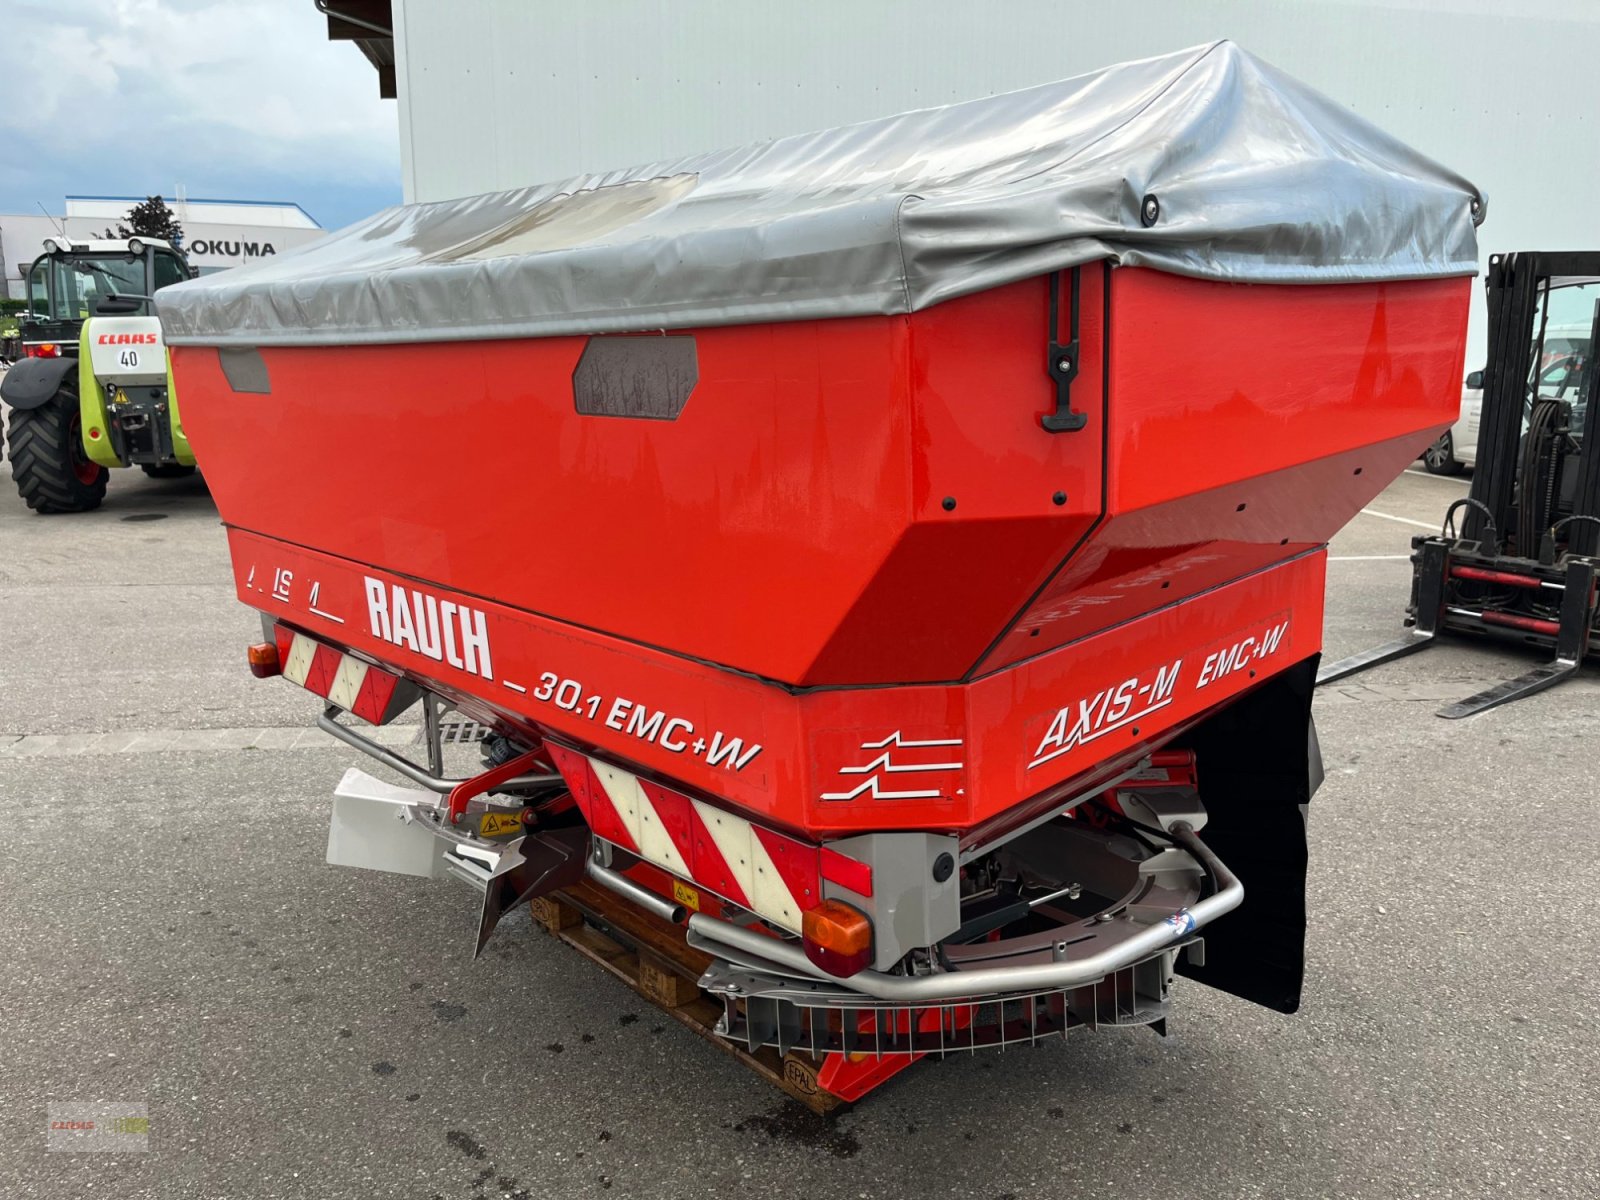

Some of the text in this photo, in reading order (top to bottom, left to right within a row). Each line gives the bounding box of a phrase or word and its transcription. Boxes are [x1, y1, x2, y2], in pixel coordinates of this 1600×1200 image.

[191, 240, 276, 256] OKUMA
[98, 333, 157, 345] CLAAS
[120, 351, 138, 367] 40
[364, 576, 493, 680] RAUCH
[1034, 621, 1288, 757] AXIS-M EMC+W
[534, 672, 762, 771] 30.1 EMC+W
[789, 1063, 814, 1092] EPAL
